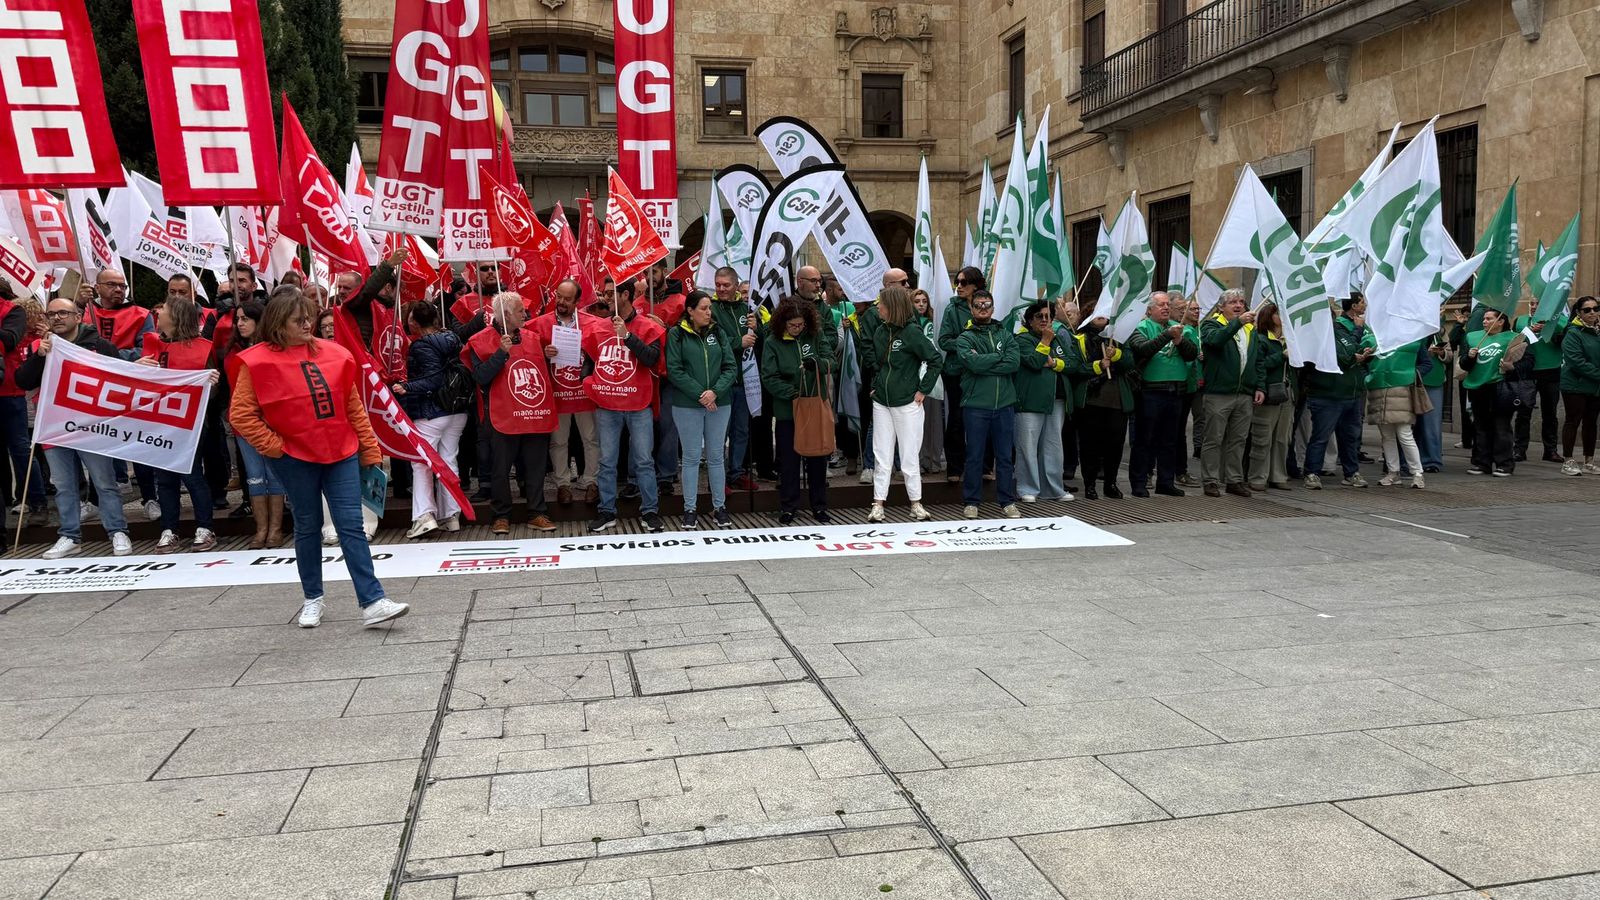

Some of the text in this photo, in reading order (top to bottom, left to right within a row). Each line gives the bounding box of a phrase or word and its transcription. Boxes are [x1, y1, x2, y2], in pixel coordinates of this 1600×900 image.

[391, 30, 452, 174] GT
[618, 0, 671, 190] UGT
[383, 181, 436, 206] UGT
[381, 198, 435, 216] Castilla
[641, 201, 673, 218] GT
[382, 212, 431, 226] y León
[452, 229, 491, 239] Castill
[455, 238, 489, 251] y Leó
[136, 238, 189, 271] jóvenes
[615, 245, 656, 273] www.ugt.es
[600, 345, 631, 362] UGT
[66, 371, 191, 419] CCOO
[122, 431, 133, 442] y
[137, 430, 173, 450] León
[26, 561, 177, 576] salario
[560, 538, 696, 552] Servicios
[703, 532, 826, 546] Públicos
[852, 529, 898, 538] de
[915, 522, 1063, 536] calidad
[816, 541, 895, 551] UGT
[446, 556, 556, 568] CCOO
